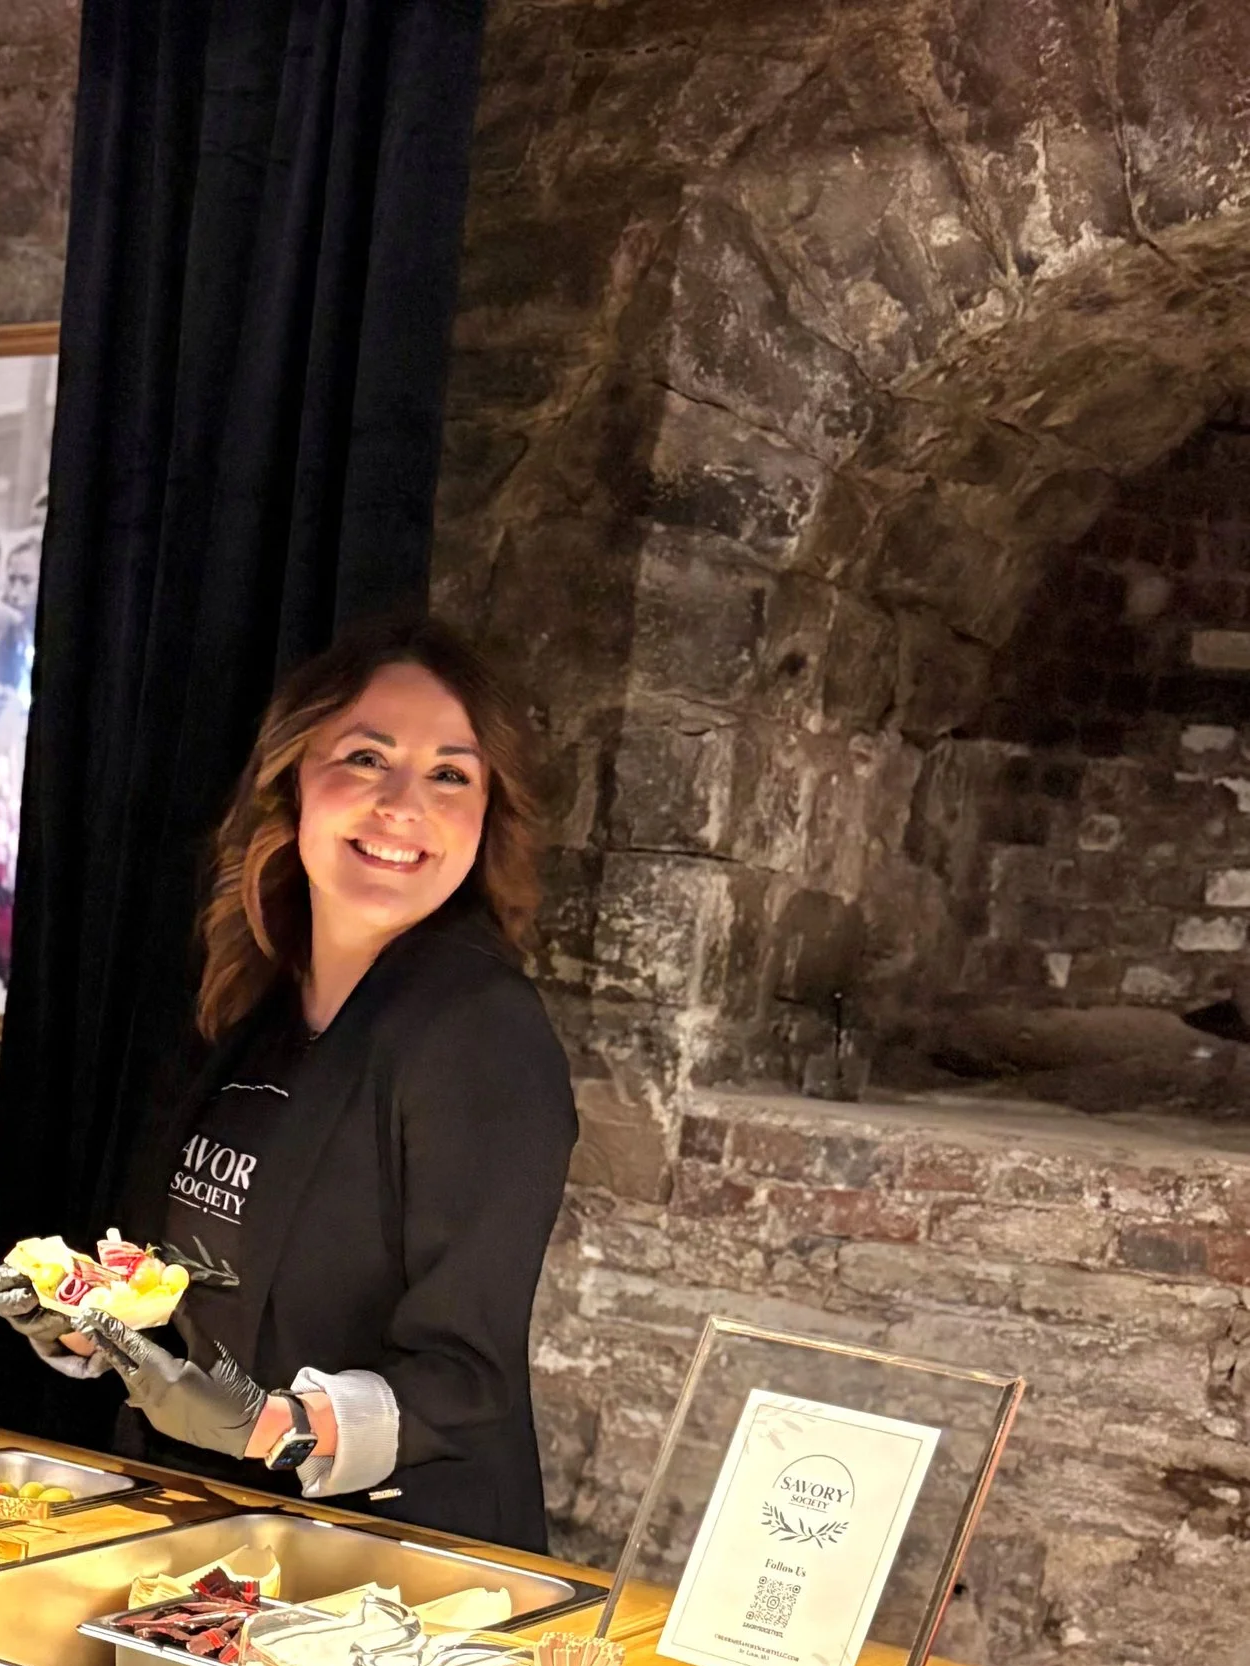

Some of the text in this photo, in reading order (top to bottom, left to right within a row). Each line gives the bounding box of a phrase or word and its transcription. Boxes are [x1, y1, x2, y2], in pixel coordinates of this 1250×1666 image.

[181, 1134, 258, 1190] AVOR
[170, 1171, 246, 1215] SOCIETY
[780, 1476, 850, 1503] SAVORY
[790, 1494, 830, 1510] SOCIETY
